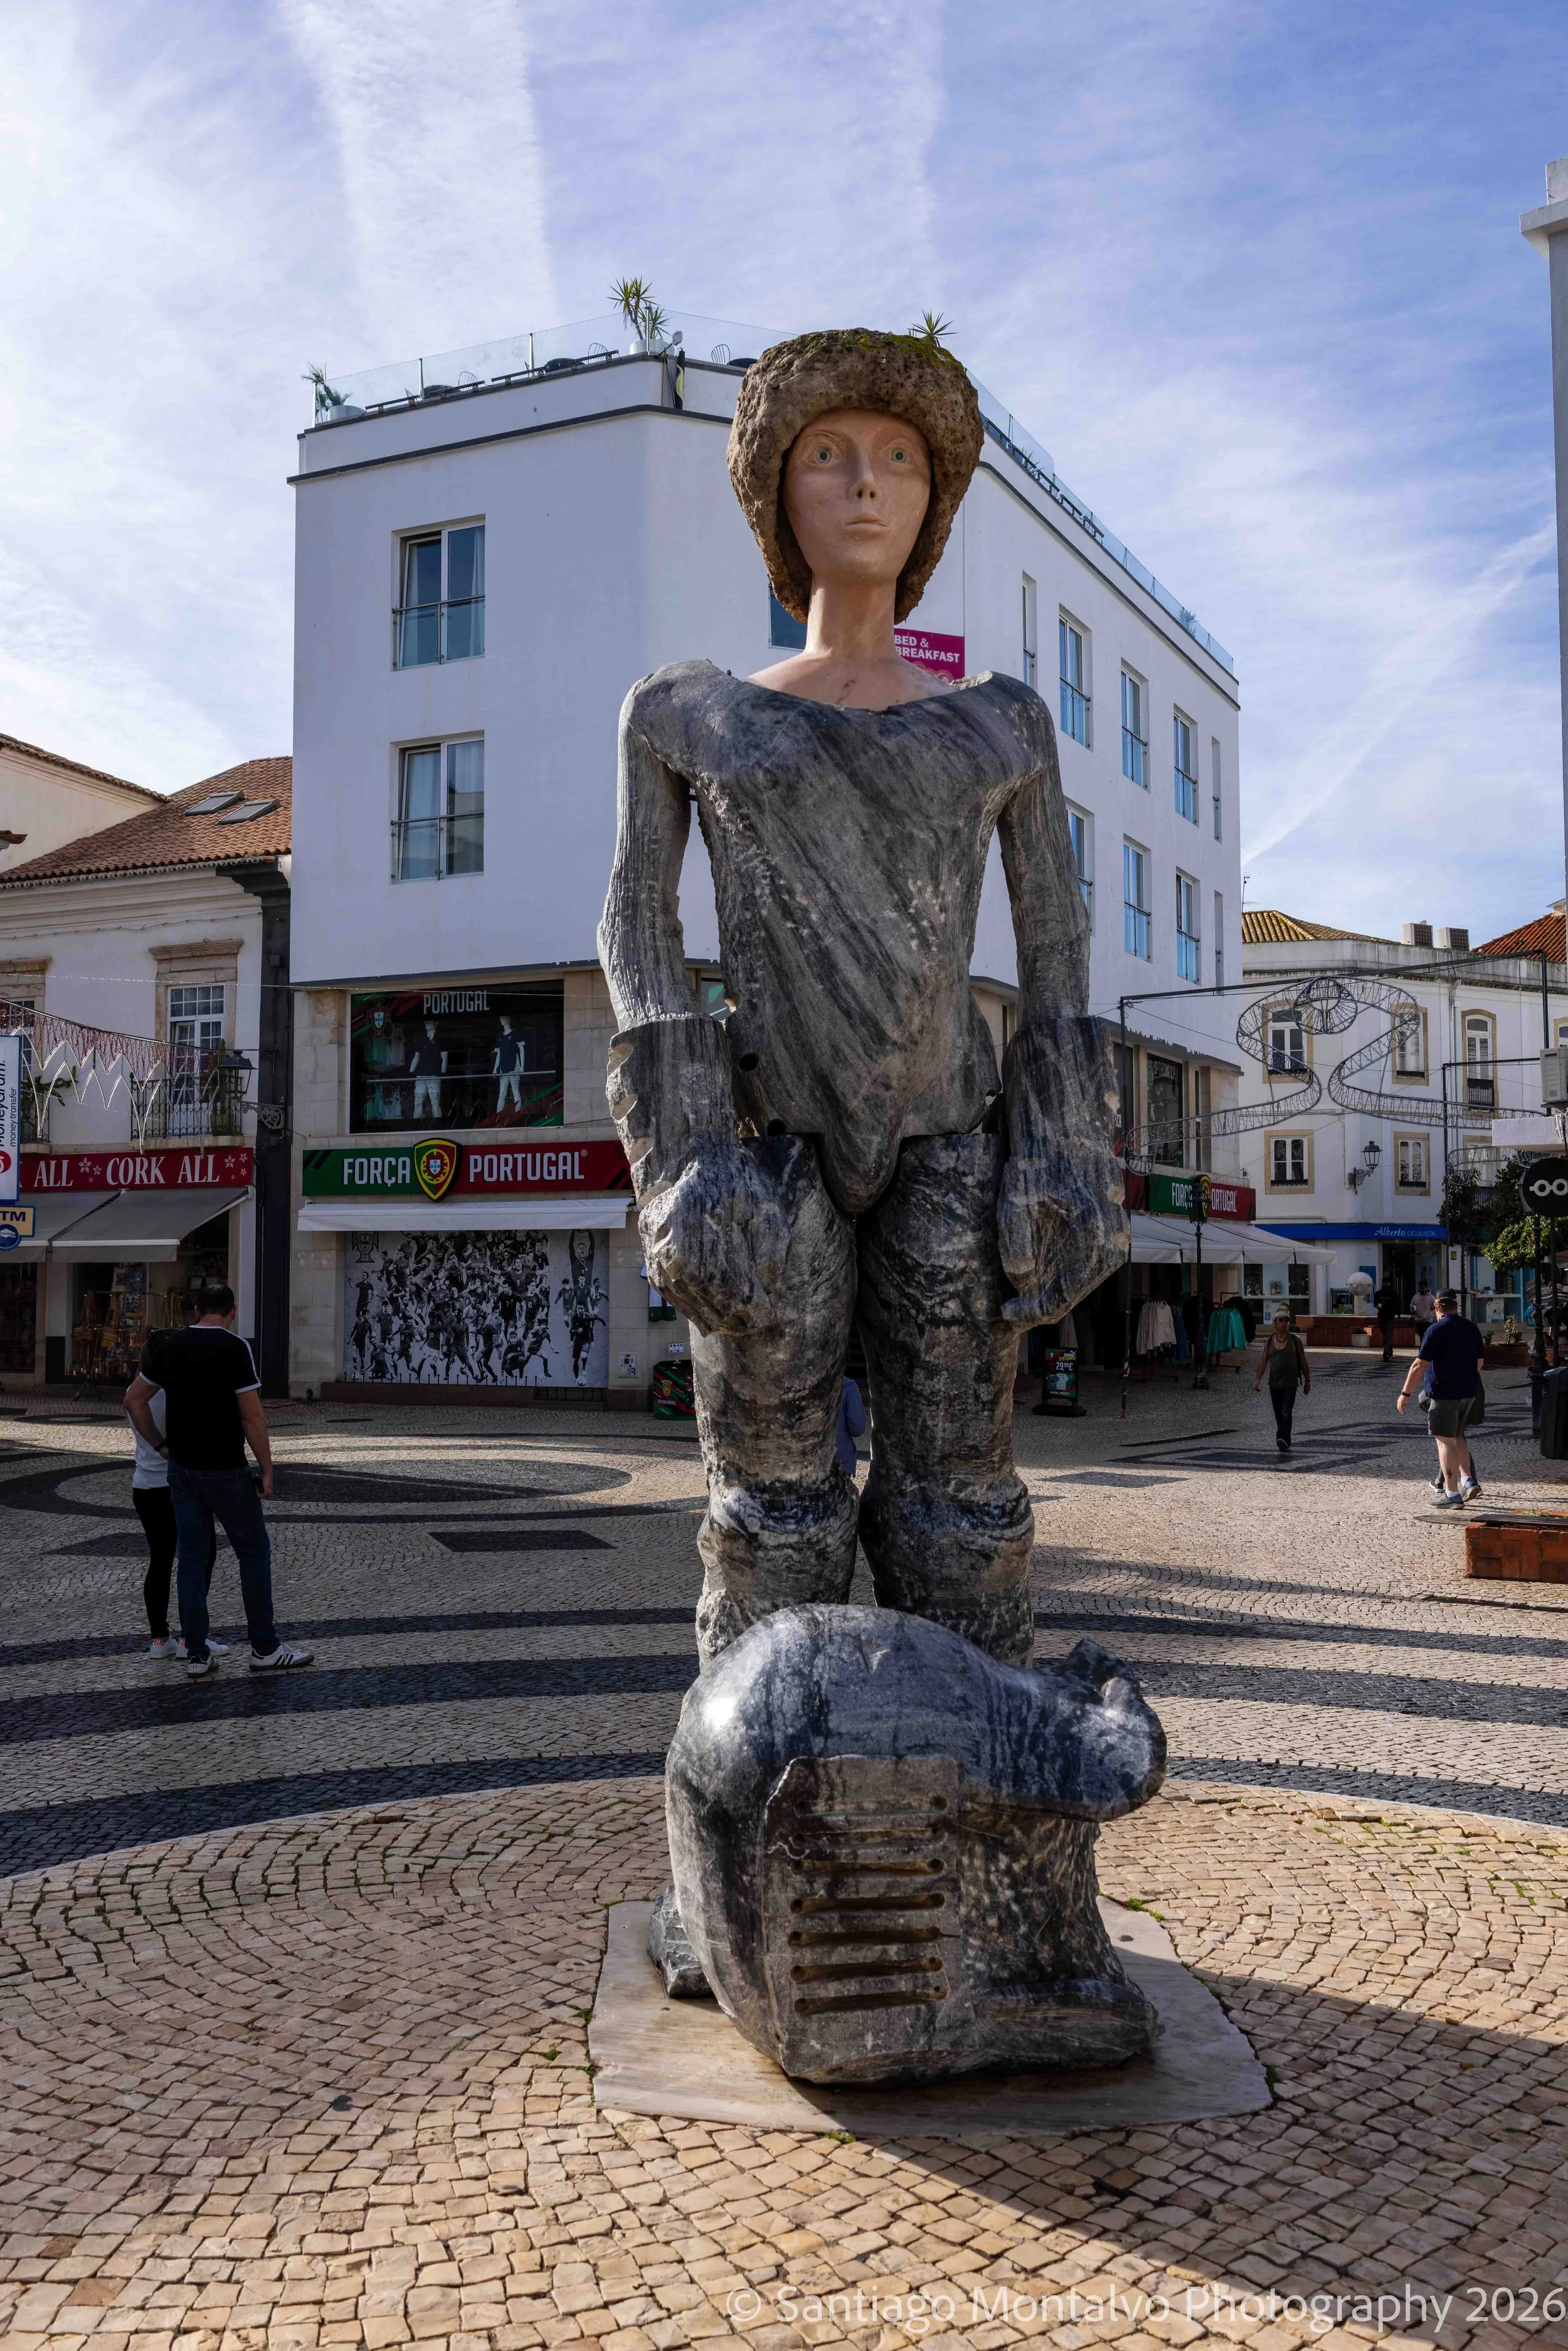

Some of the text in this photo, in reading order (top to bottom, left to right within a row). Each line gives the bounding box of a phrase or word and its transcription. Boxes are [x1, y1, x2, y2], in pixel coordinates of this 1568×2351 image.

[894, 635, 928, 649] BED &
[896, 647, 960, 664] BREAKFAST
[423, 990, 490, 1015] PORTUGAL
[9, 1087, 18, 1147] money transfer
[33, 1160, 73, 1187] ALL
[106, 1154, 221, 1186] CORK ALL
[343, 1157, 410, 1187] FORÇA
[1212, 1188, 1237, 1213] ORTUGAL
[1374, 1226, 1406, 1236] Alberto
